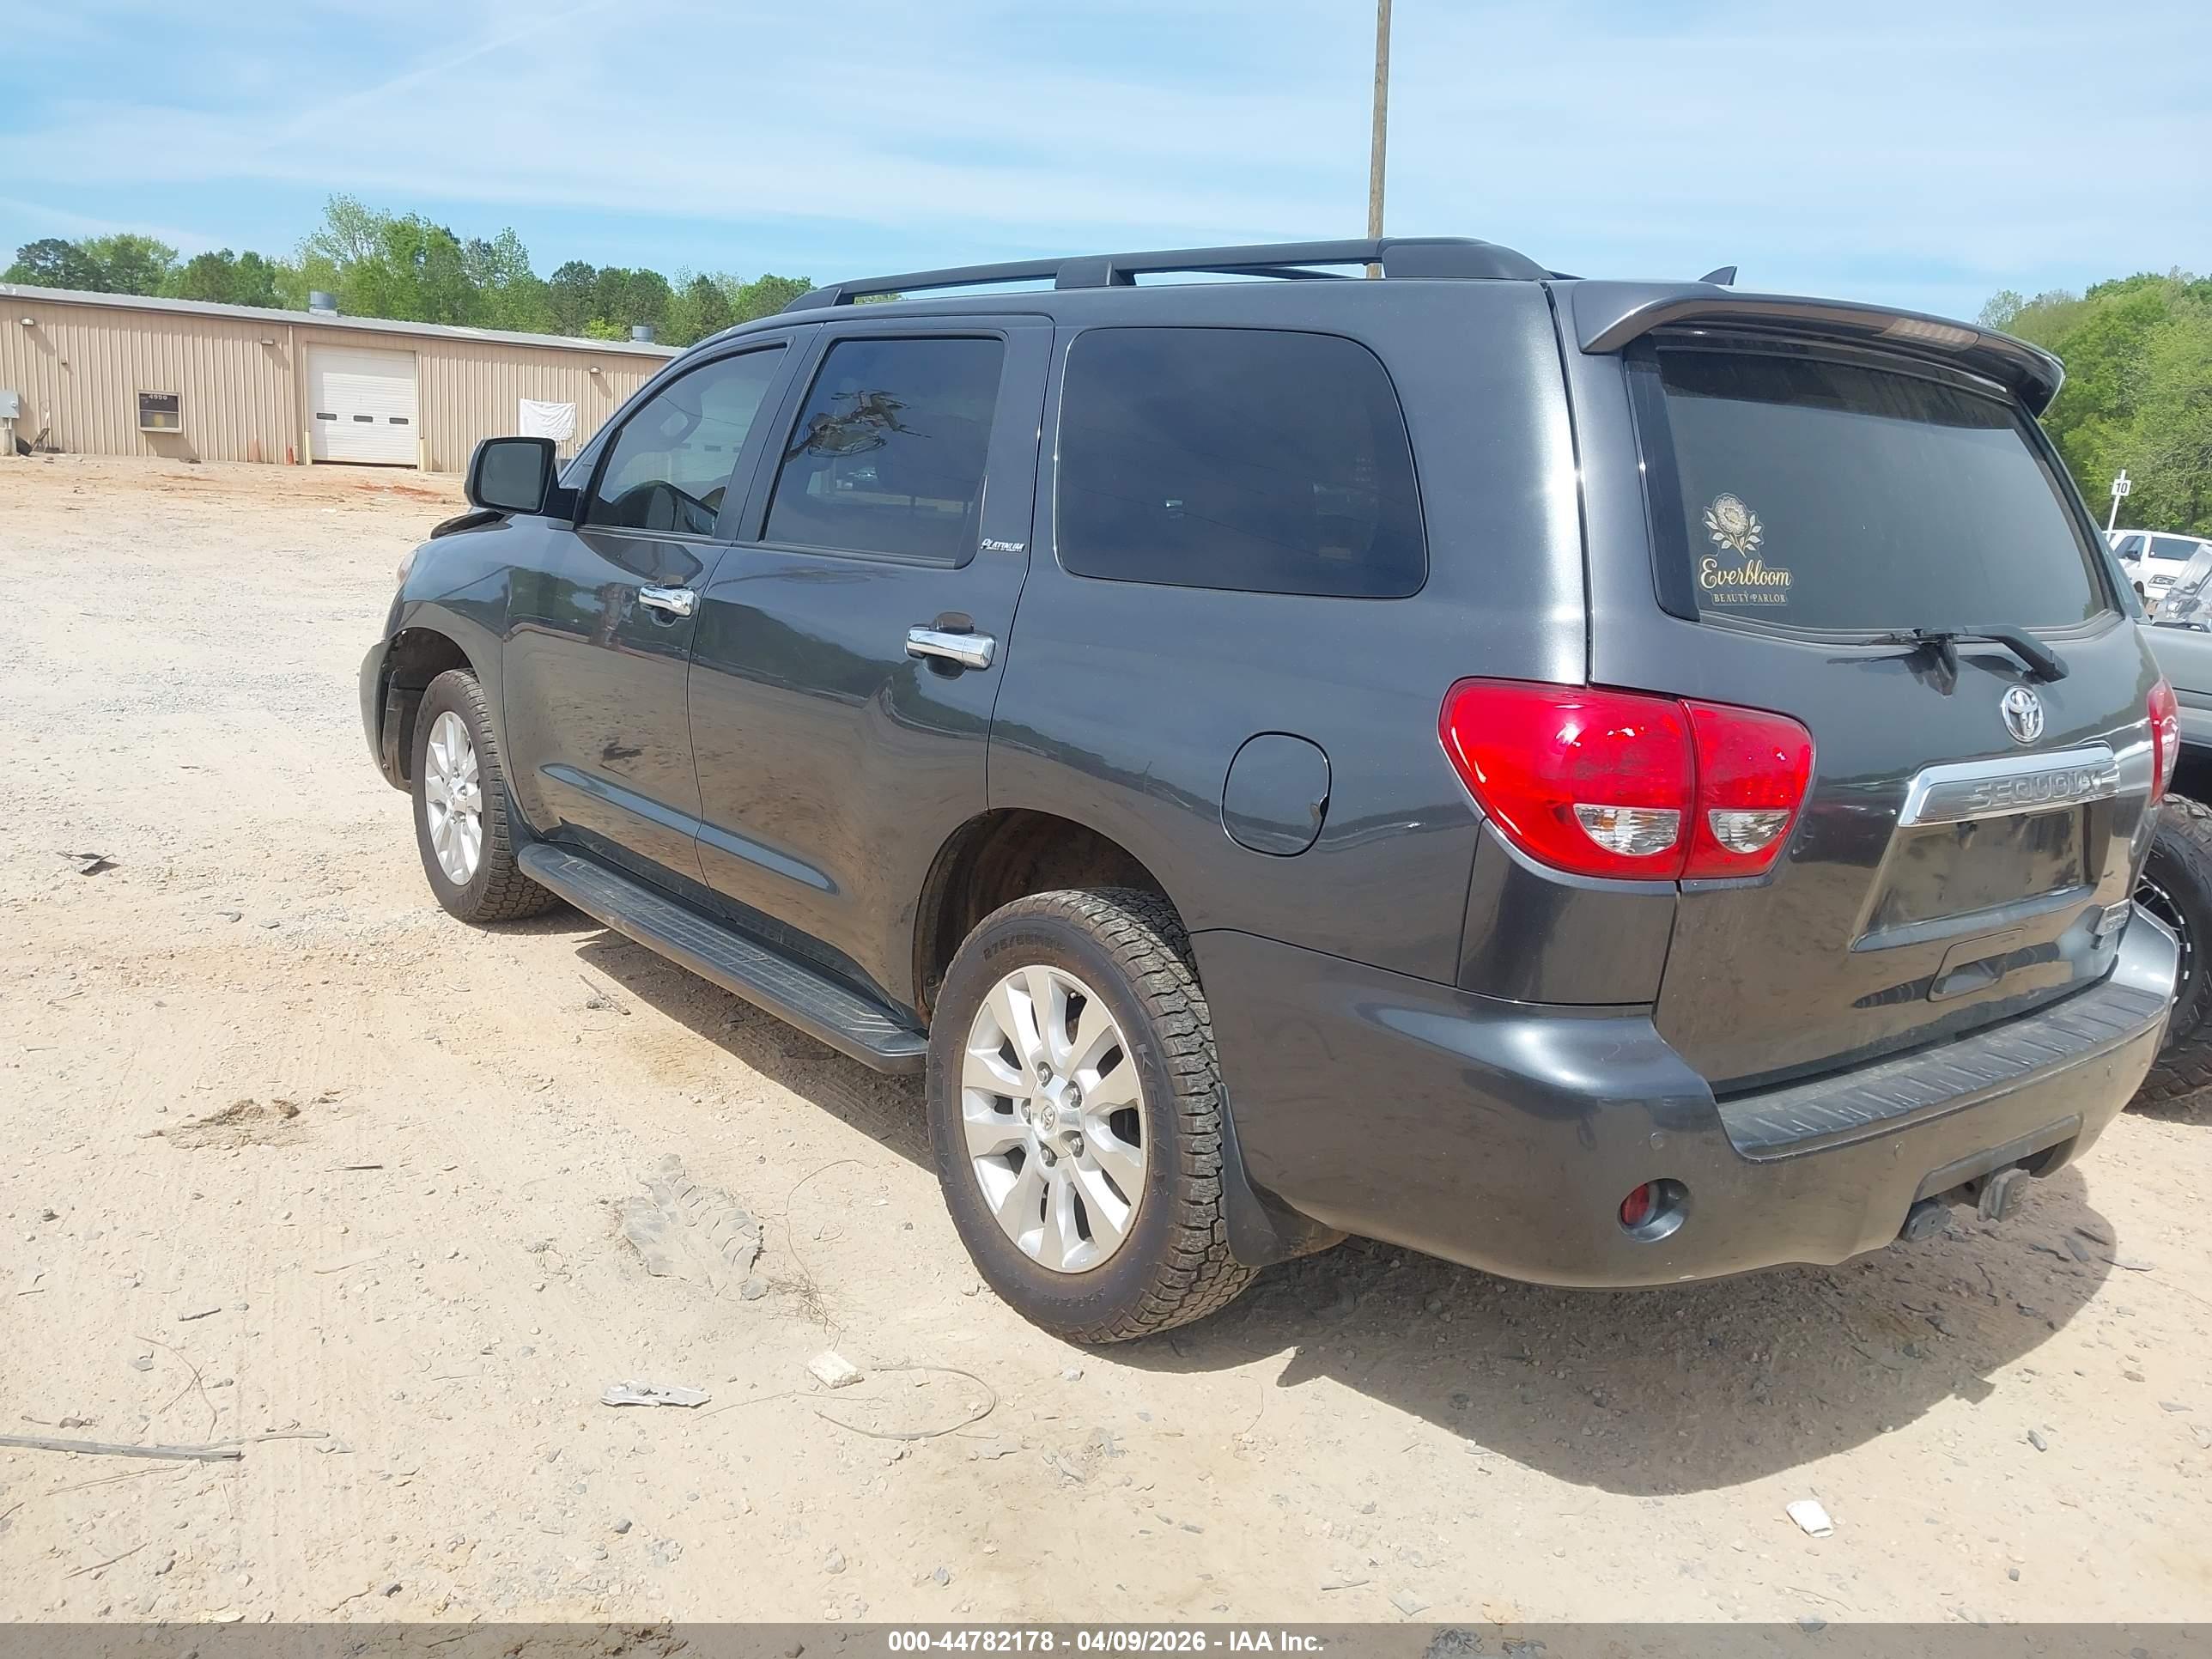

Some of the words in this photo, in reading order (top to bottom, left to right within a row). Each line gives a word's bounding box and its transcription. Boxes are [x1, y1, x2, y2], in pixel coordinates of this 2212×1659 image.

[2117, 483, 2128, 493] 10
[1700, 558, 1791, 589] Everbloom
[1713, 592, 1749, 603] BEAUTY
[1752, 593, 1786, 603] PARLOR
[1968, 769, 2100, 811] SEQUOIA
